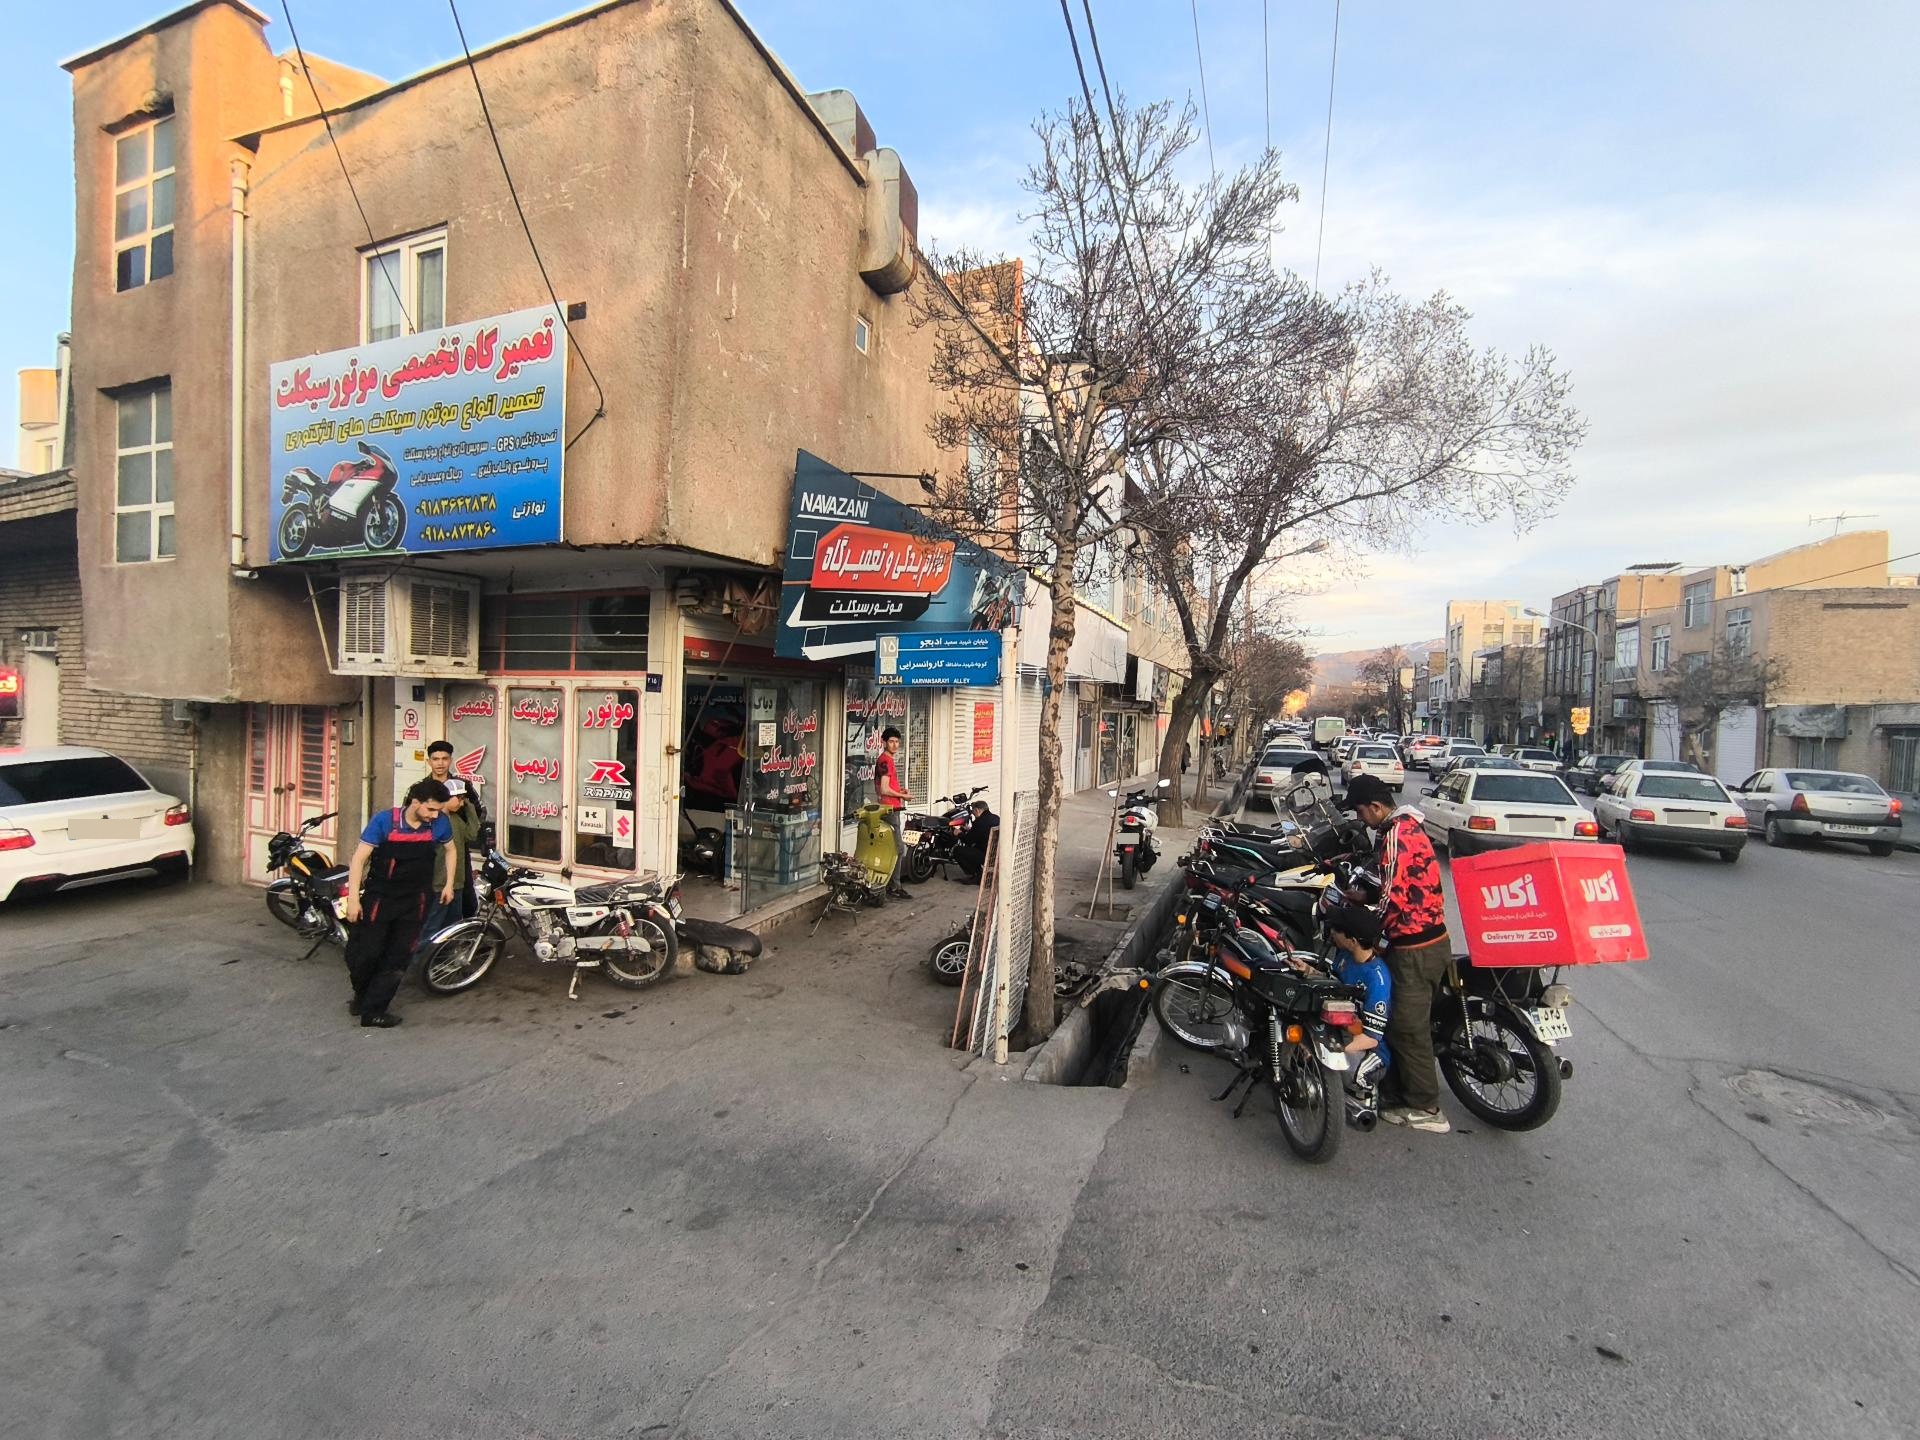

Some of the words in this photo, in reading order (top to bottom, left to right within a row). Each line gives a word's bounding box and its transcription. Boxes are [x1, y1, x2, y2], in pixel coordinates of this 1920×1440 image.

[382, 337, 460, 398] تخصصی
[462, 394, 496, 429] انواع
[500, 387, 545, 419] تعمیر
[338, 417, 364, 443] های
[541, 429, 557, 446] نصب
[466, 442, 488, 456] سرویس
[497, 436, 514, 452] GPS
[512, 500, 546, 519] نوازنی
[800, 492, 868, 518] NAVAZANI
[822, 536, 889, 580] تعمیرگاه
[884, 551, 894, 578] و
[892, 545, 923, 581] یدکی
[883, 641, 896, 653] ۱۵
[973, 638, 989, 647] خیابان
[900, 660, 944, 671] کاروانسرایی
[962, 661, 975, 669] شهید
[975, 661, 988, 669] کوچه
[452, 692, 494, 722] تخصصی
[512, 696, 559, 725] تیونینگ
[583, 696, 633, 728] موتور
[512, 757, 559, 783] ریمپ
[580, 821, 604, 829] Kawasaki
[1516, 932, 1525, 940] by
